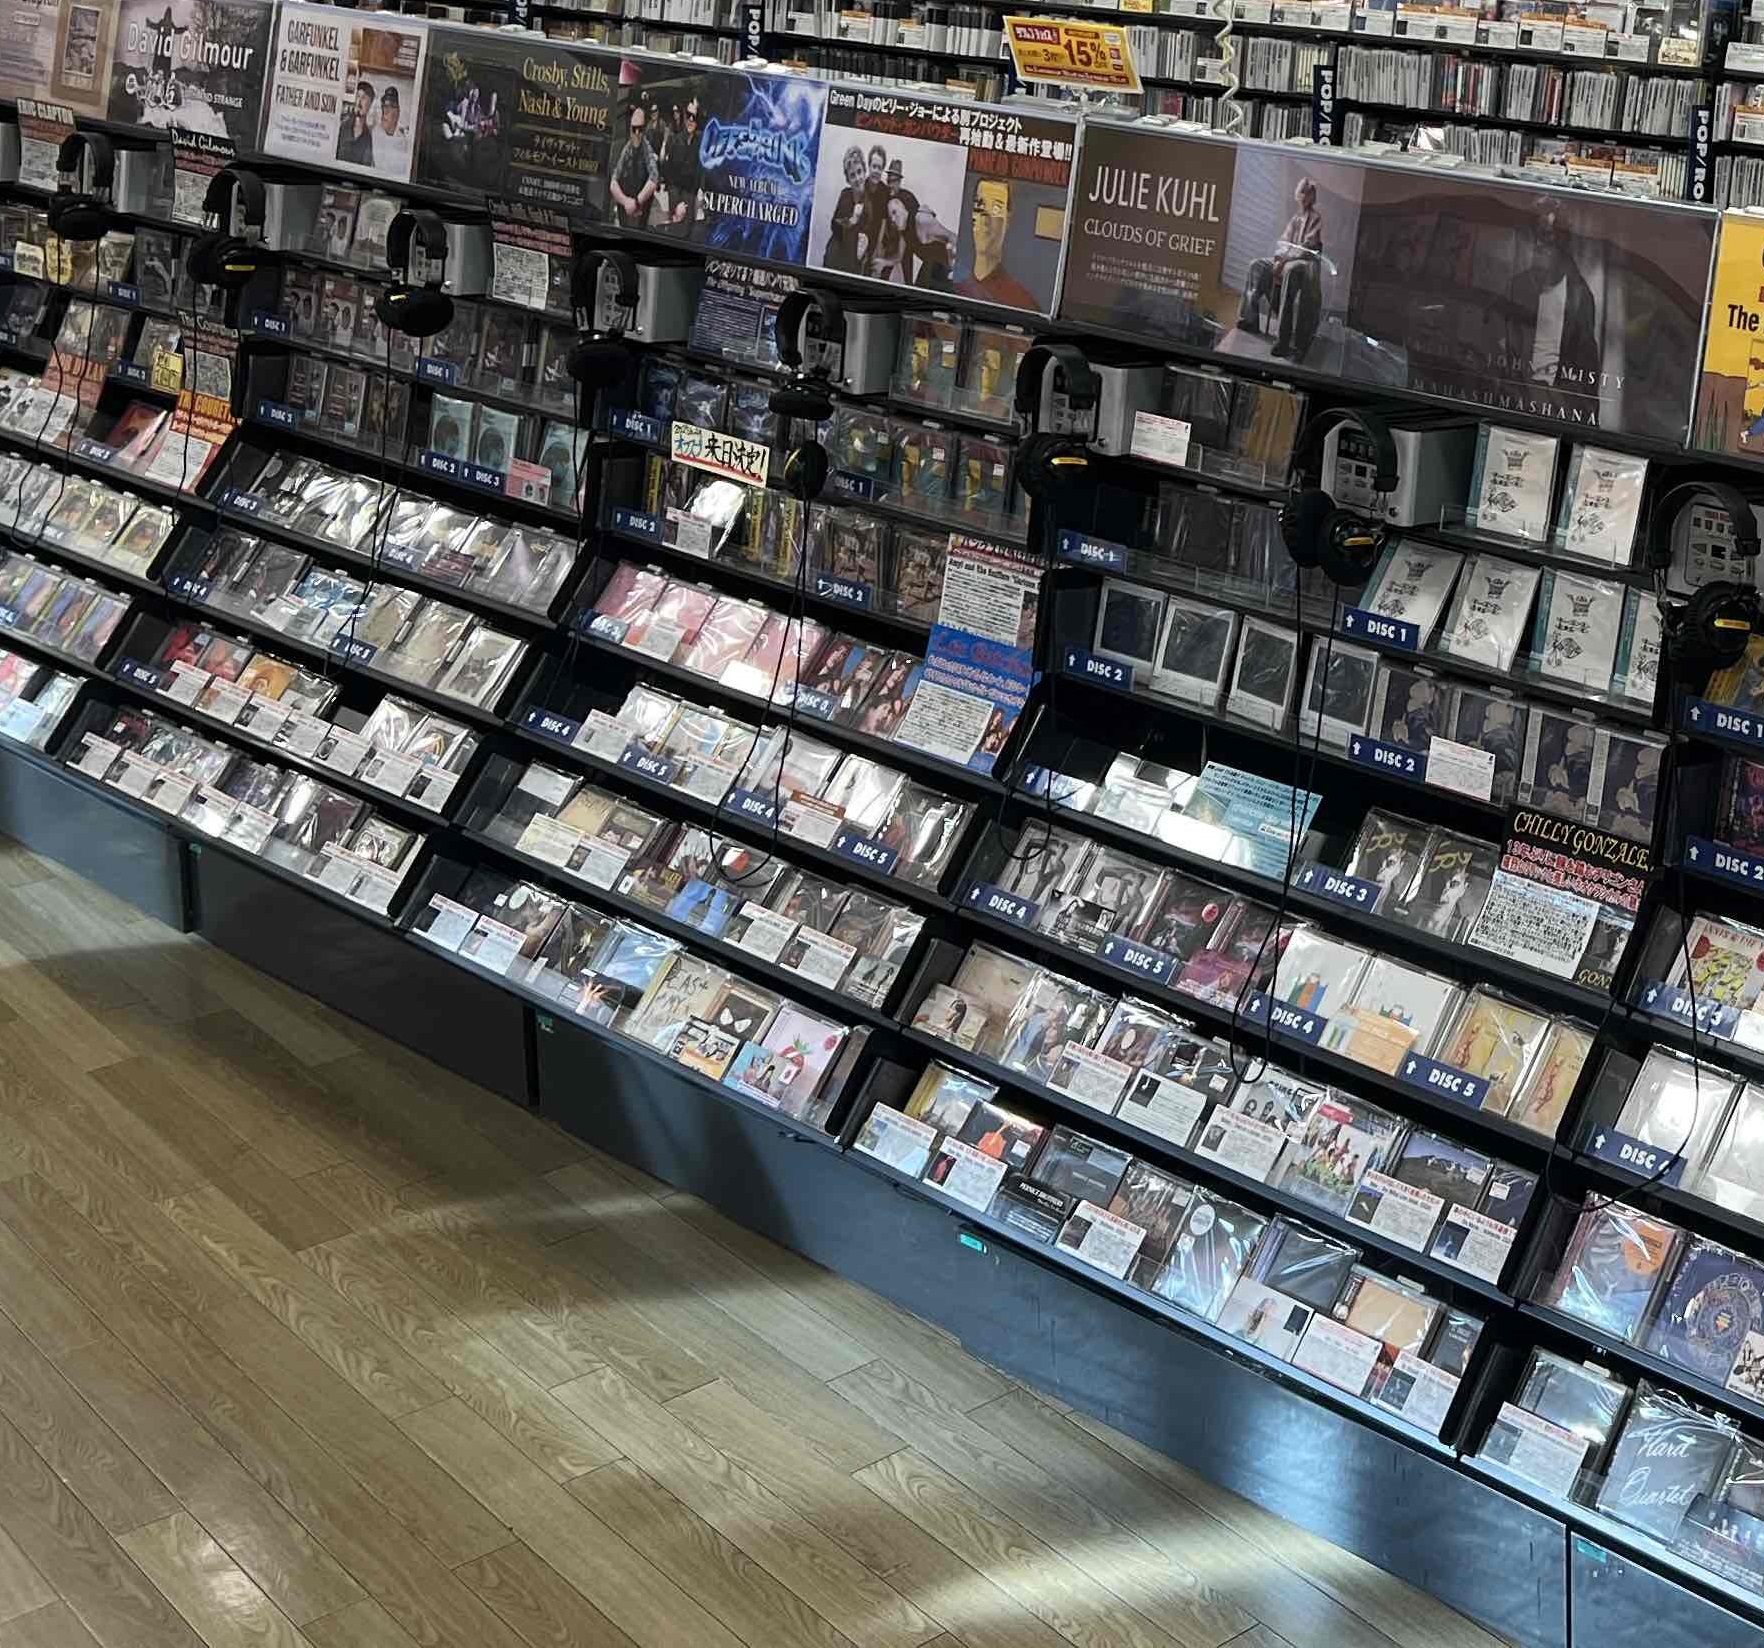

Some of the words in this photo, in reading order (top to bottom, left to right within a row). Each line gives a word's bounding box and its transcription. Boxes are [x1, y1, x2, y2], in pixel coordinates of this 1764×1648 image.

[128, 23, 174, 58] David
[180, 30, 254, 71] Gilmour
[287, 19, 340, 51] GARFUNKEL
[280, 49, 288, 72] &
[288, 50, 341, 82] GARFUNKEL
[523, 57, 568, 88] Crosby,
[571, 64, 610, 95] Stills,
[275, 84, 304, 105] FATHER
[305, 90, 320, 110] AND
[321, 94, 337, 114] SON
[517, 89, 551, 114] Nash
[552, 98, 563, 118] &
[565, 101, 608, 129] Young
[830, 90, 855, 107] Green
[1089, 165, 1149, 211] JULIE
[1156, 176, 1220, 223] KUHL
[703, 189, 799, 227] SUPERCHARGED
[1084, 218, 1143, 247] CLOUDS
[1145, 229, 1164, 249] OF
[1168, 232, 1217, 259] GRIEF
[1728, 304, 1760, 332] The
[1558, 365, 1625, 390] MISTY
[1367, 619, 1397, 639] DISC
[1400, 626, 1407, 642] 1
[1087, 660, 1113, 677] DISC
[1114, 666, 1123, 681] 2
[541, 715, 559, 732] DISC
[559, 721, 570, 737] 4
[1716, 712, 1751, 734] DISC
[1756, 720, 1764, 738] 1
[635, 753, 656, 773] DISC
[1374, 747, 1404, 768] DISC
[1406, 757, 1415, 772] 2
[742, 795, 764, 814] DISC
[764, 803, 775, 820] 4
[852, 838, 876, 860] DISC
[1513, 811, 1575, 846] CHILLY
[1573, 829, 1653, 872] GONZALE
[1714, 854, 1750, 878] DISC
[1753, 863, 1764, 882] 2
[1324, 877, 1357, 898] DISC
[1358, 888, 1367, 901] 3
[990, 893, 1013, 913] DISC
[1014, 902, 1026, 918] 4
[1123, 950, 1150, 970] DISC
[1151, 957, 1162, 974] 5
[1271, 1005, 1298, 1027] DISC
[1300, 1016, 1313, 1034] 4
[1709, 1008, 1722, 1028] 3
[1428, 1068, 1462, 1092] DISC
[1463, 1082, 1476, 1097] 5
[1619, 1142, 1654, 1168] DISC
